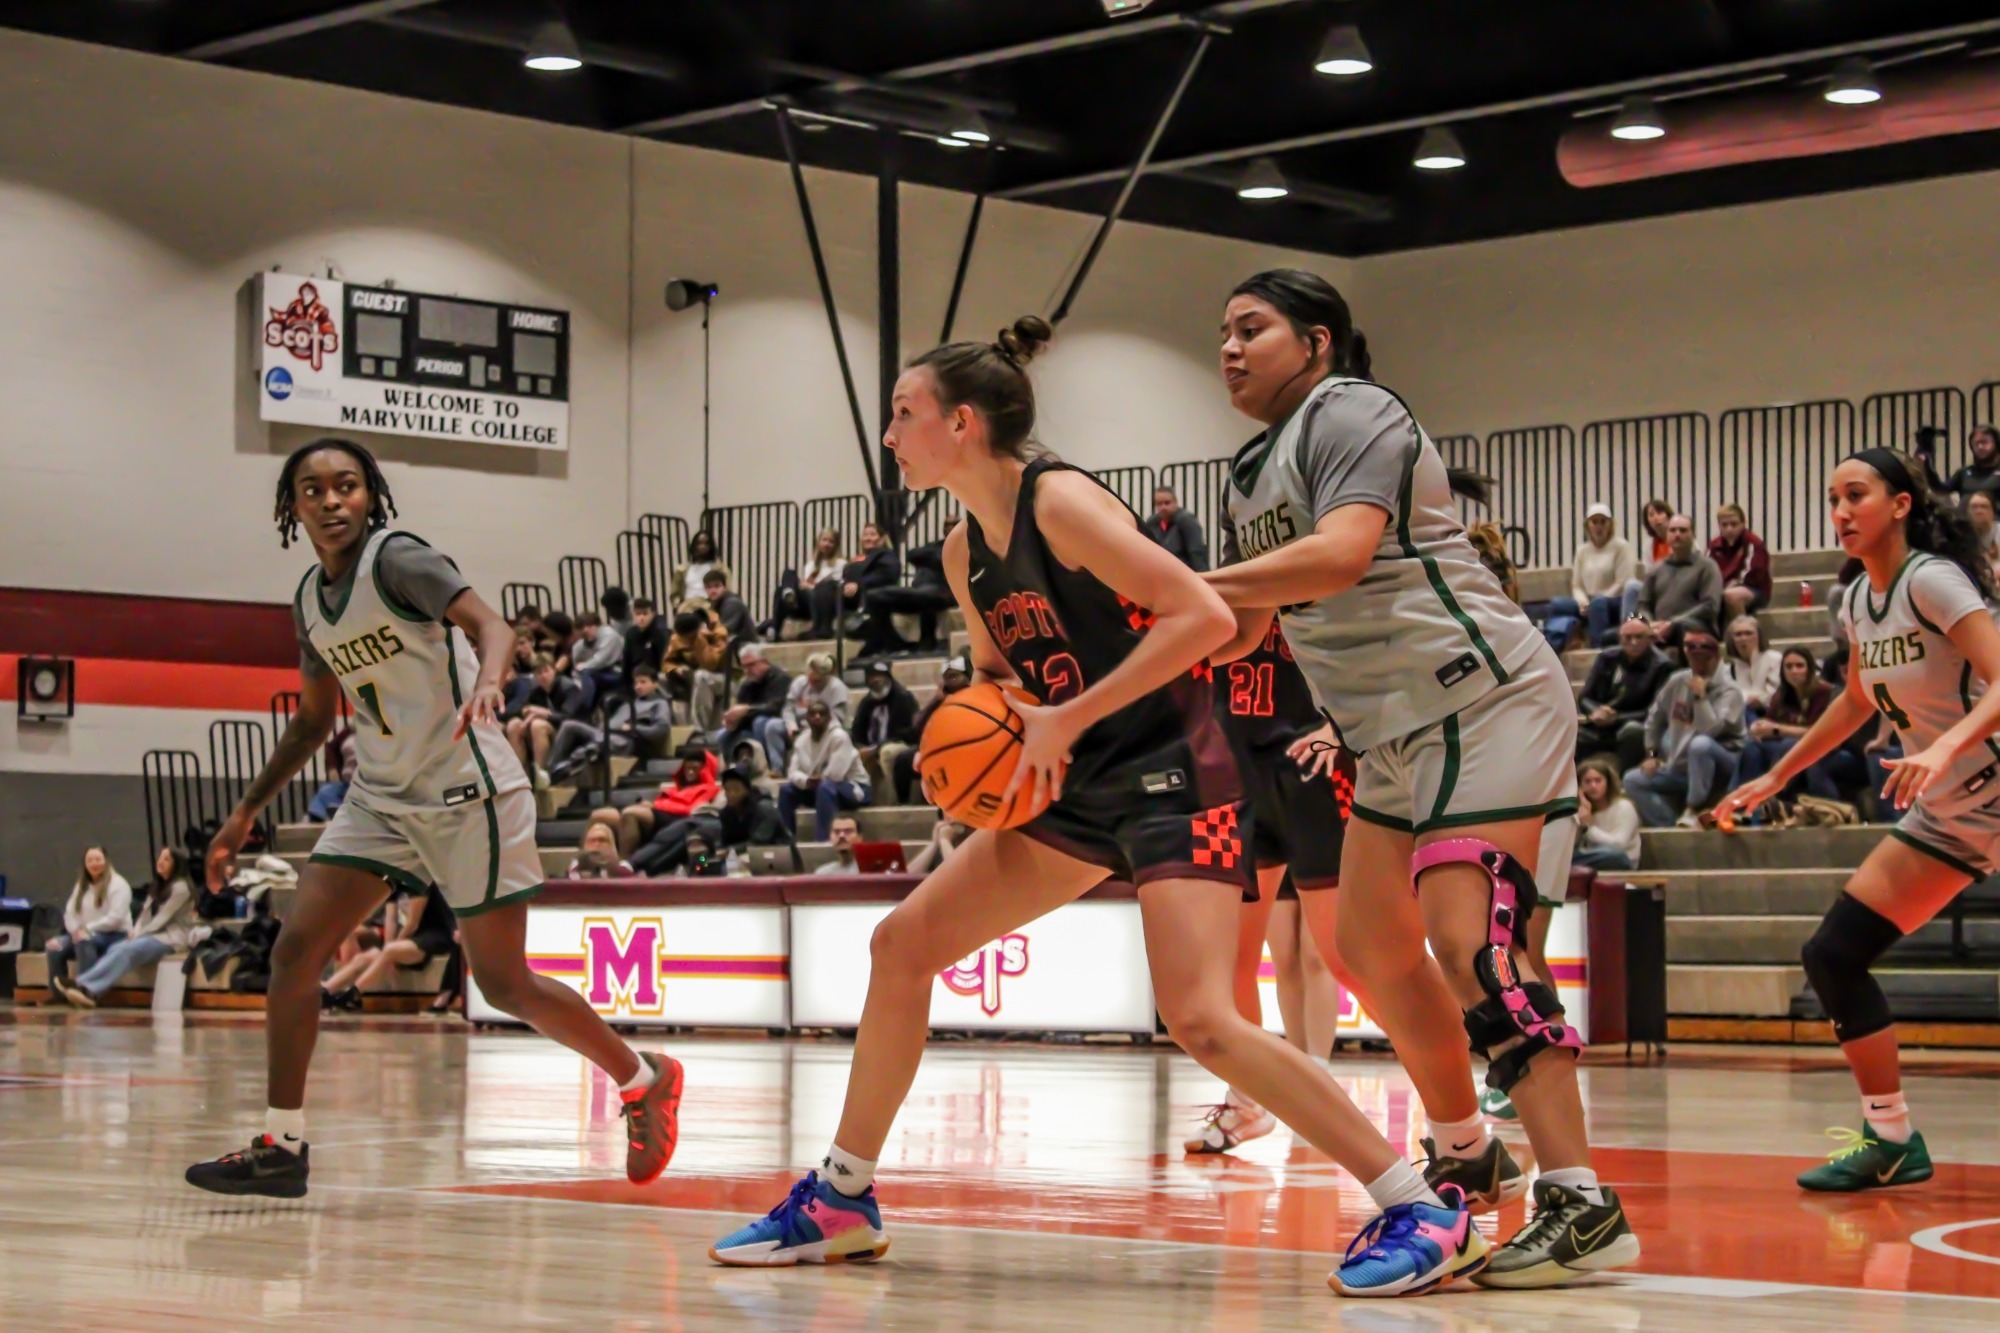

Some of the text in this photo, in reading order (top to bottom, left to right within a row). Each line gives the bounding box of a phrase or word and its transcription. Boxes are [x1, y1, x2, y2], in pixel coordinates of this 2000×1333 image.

[353, 291, 407, 312] GUEST
[513, 312, 558, 331] HOME
[416, 358, 463, 375] PERIOD
[384, 389, 519, 418] WELCOME TO
[340, 406, 558, 444] MARYVILLE COLLEGE
[1241, 501, 1296, 560] AZERS
[327, 625, 404, 676] AZERS
[1859, 631, 1925, 669] AZERS
[1228, 662, 1274, 716] 21
[1873, 683, 1911, 730] 4
[584, 922, 662, 1010] M
